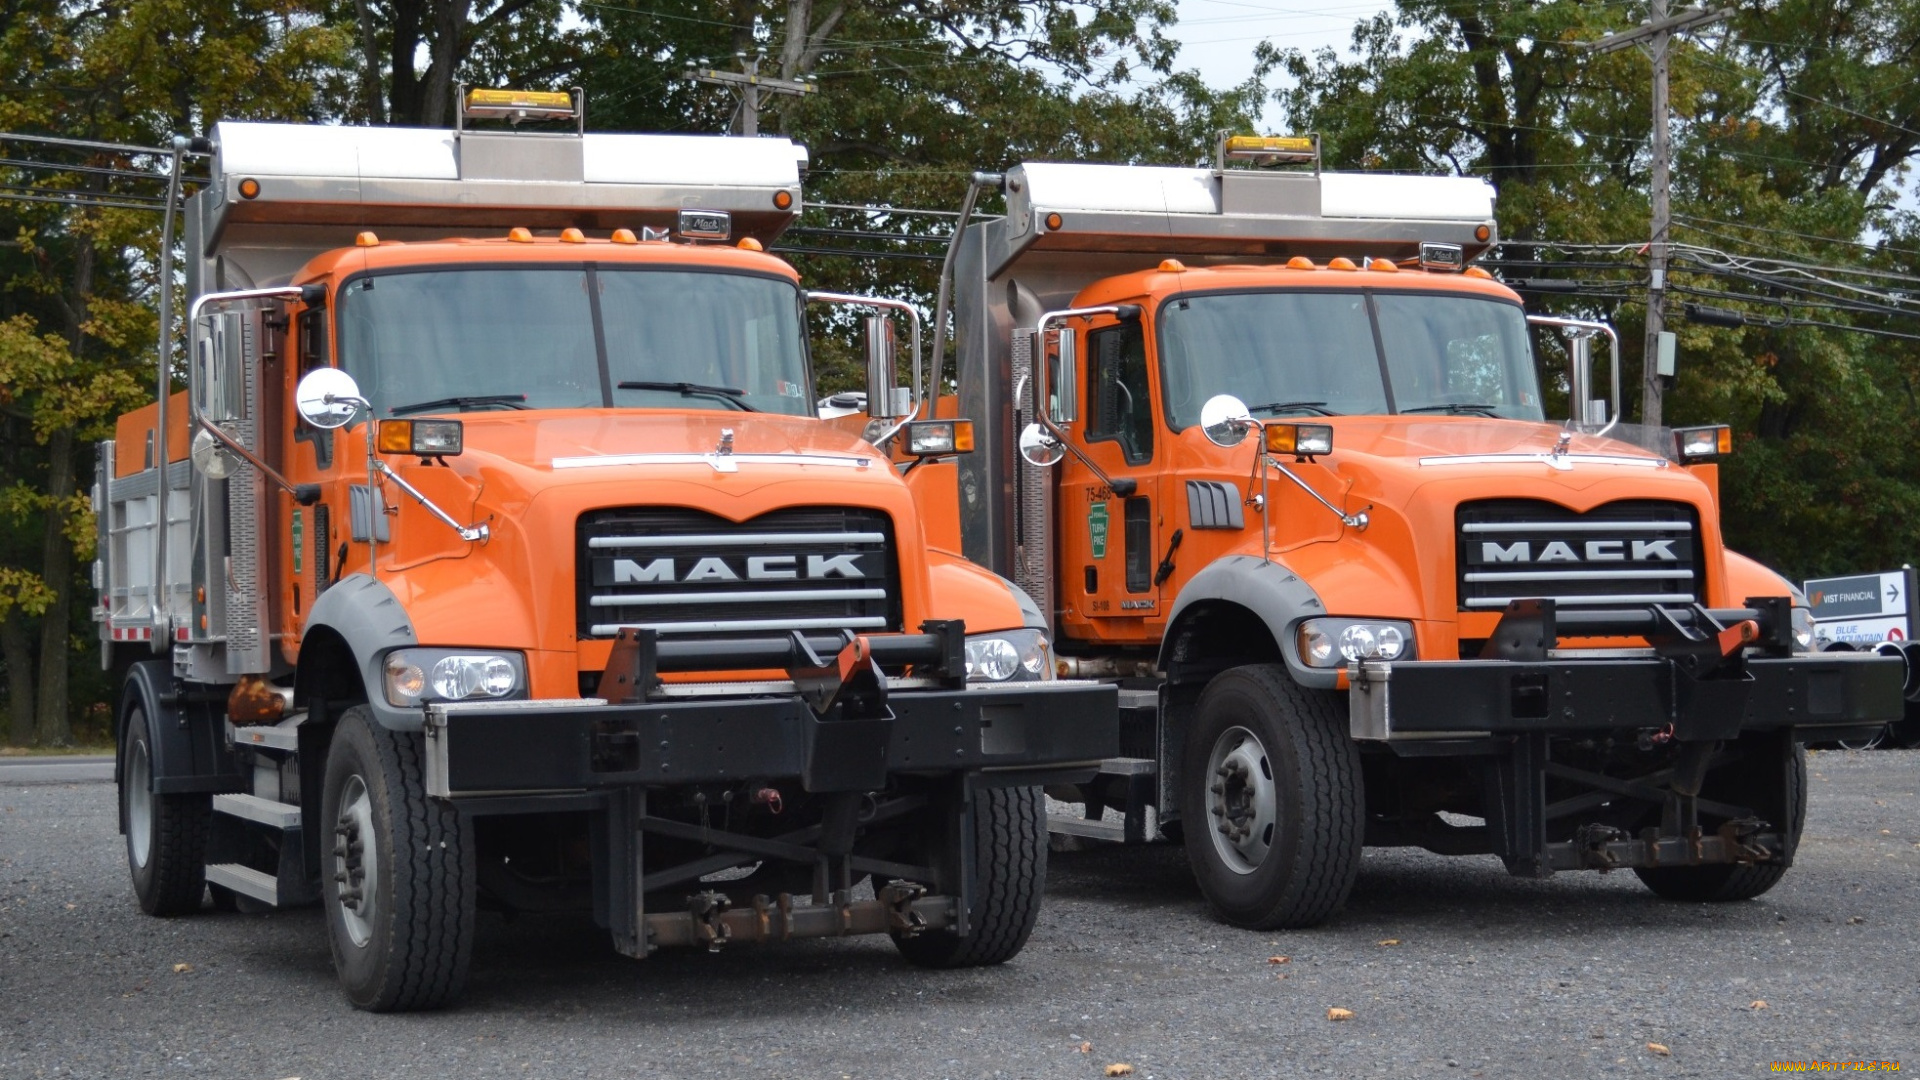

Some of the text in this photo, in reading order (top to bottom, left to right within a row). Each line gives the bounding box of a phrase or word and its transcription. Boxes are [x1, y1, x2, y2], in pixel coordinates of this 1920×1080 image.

[693, 218, 719, 230] Mack
[1482, 540, 1678, 562] MACK
[614, 554, 866, 583] MACK
[1823, 591, 1875, 603] VIST FINANCIAL
[1121, 600, 1155, 609] MACK
[1835, 625, 1858, 635] BLUE
